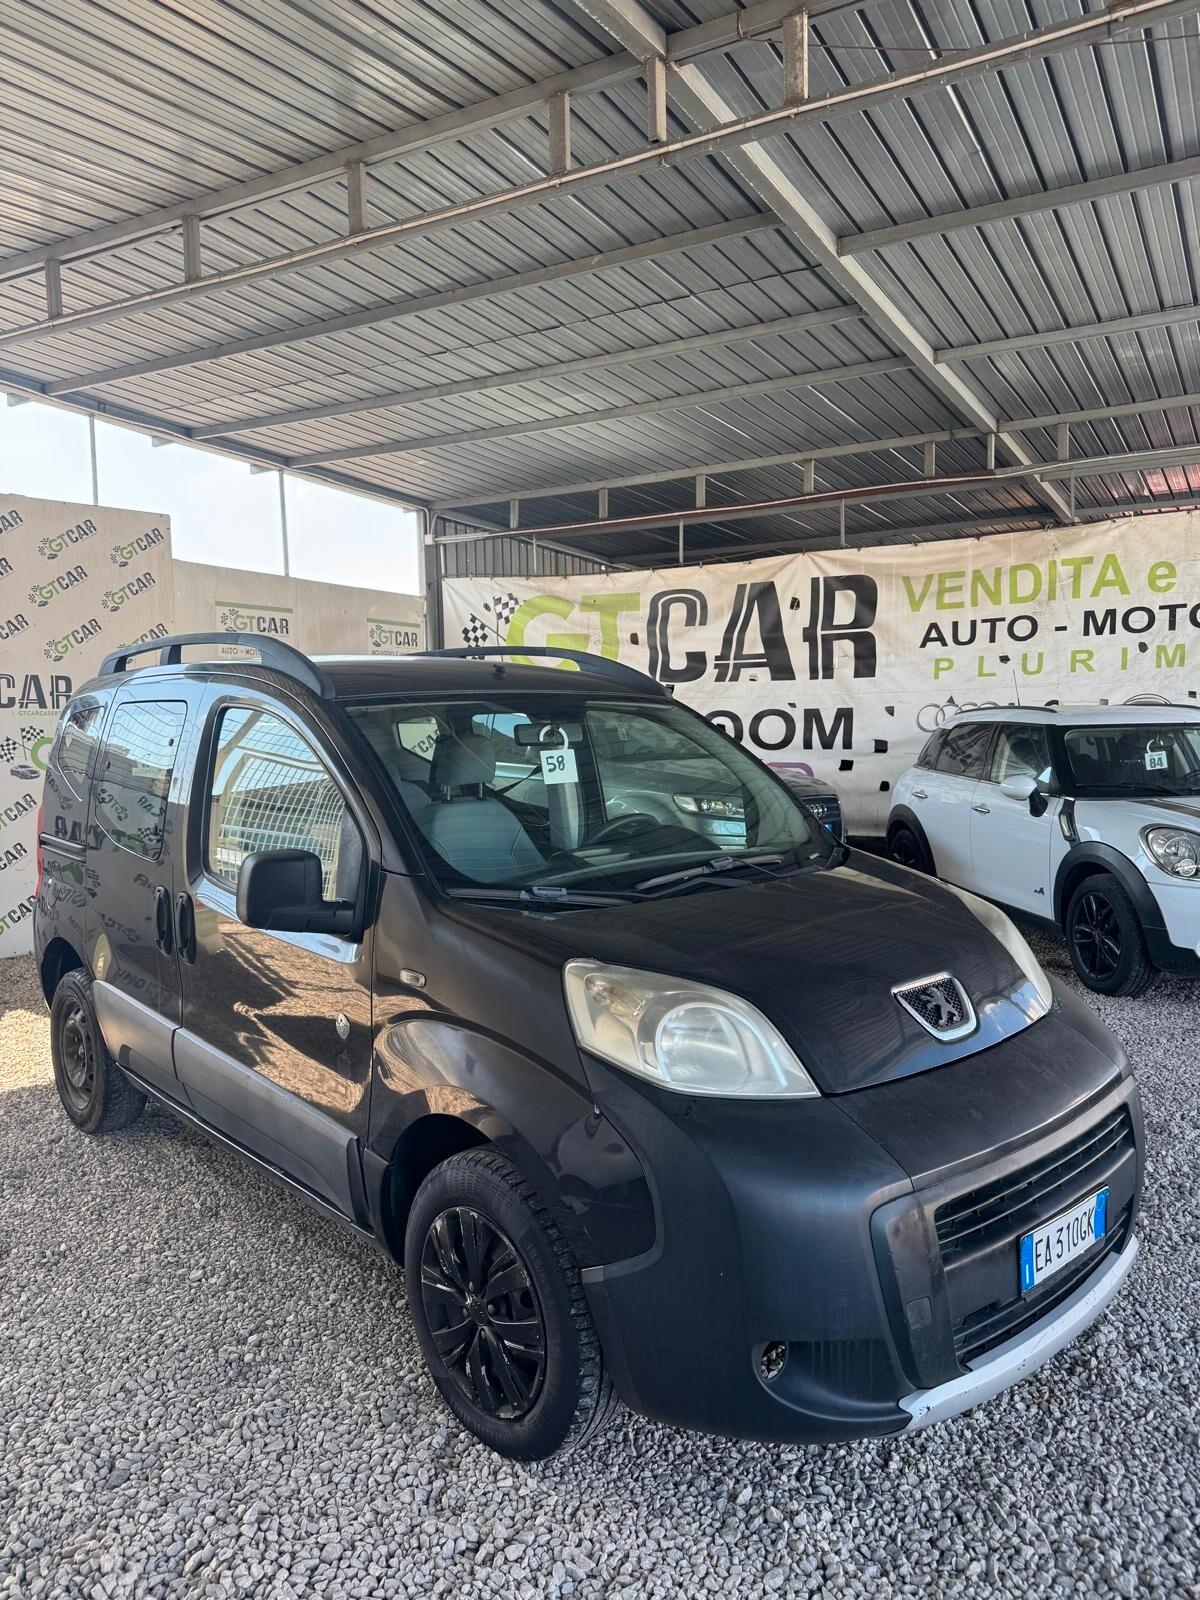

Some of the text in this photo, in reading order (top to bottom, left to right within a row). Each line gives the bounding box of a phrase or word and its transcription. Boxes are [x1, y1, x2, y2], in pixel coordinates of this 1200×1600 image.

[48, 519, 97, 553] GTCAR
[120, 528, 164, 560] GTCAR
[39, 565, 88, 600] GTCAR
[111, 572, 156, 605] GTCAR
[902, 553, 1178, 612] VENDITA e
[54, 618, 102, 656] GTCAR
[234, 615, 289, 635] GTCAR
[379, 629, 417, 647] GTCAR
[919, 615, 1038, 648] AUTO
[546, 755, 565, 773] 58
[1149, 756, 1164, 769] 84
